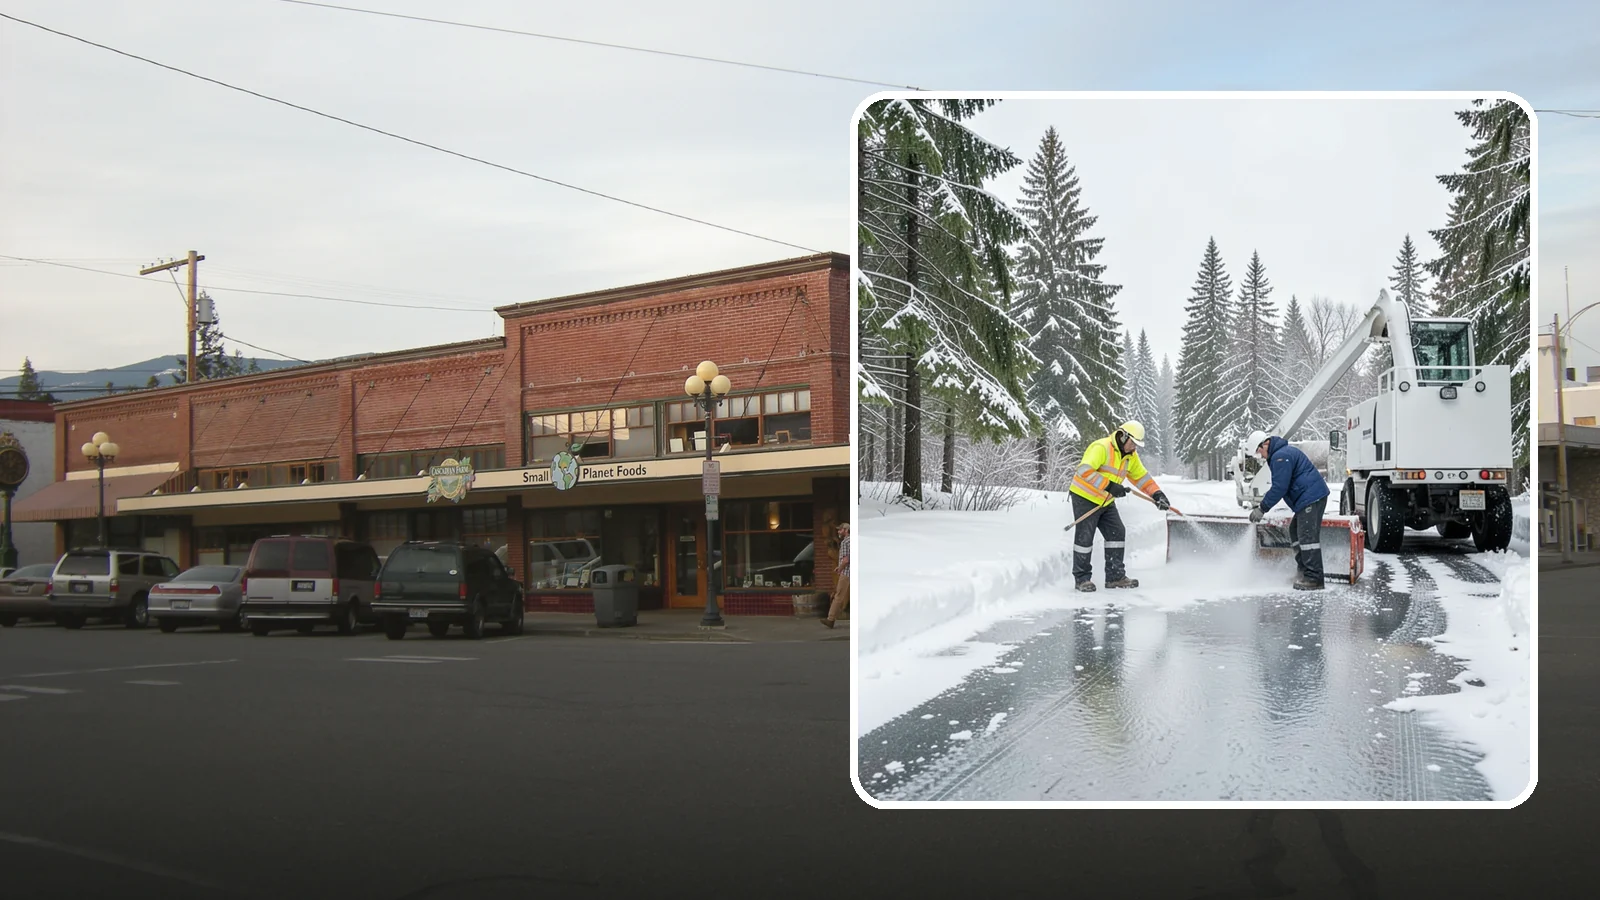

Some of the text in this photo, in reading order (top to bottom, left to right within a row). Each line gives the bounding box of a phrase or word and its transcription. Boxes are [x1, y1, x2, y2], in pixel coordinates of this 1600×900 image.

[523, 464, 647, 482] Small Planet Foods
